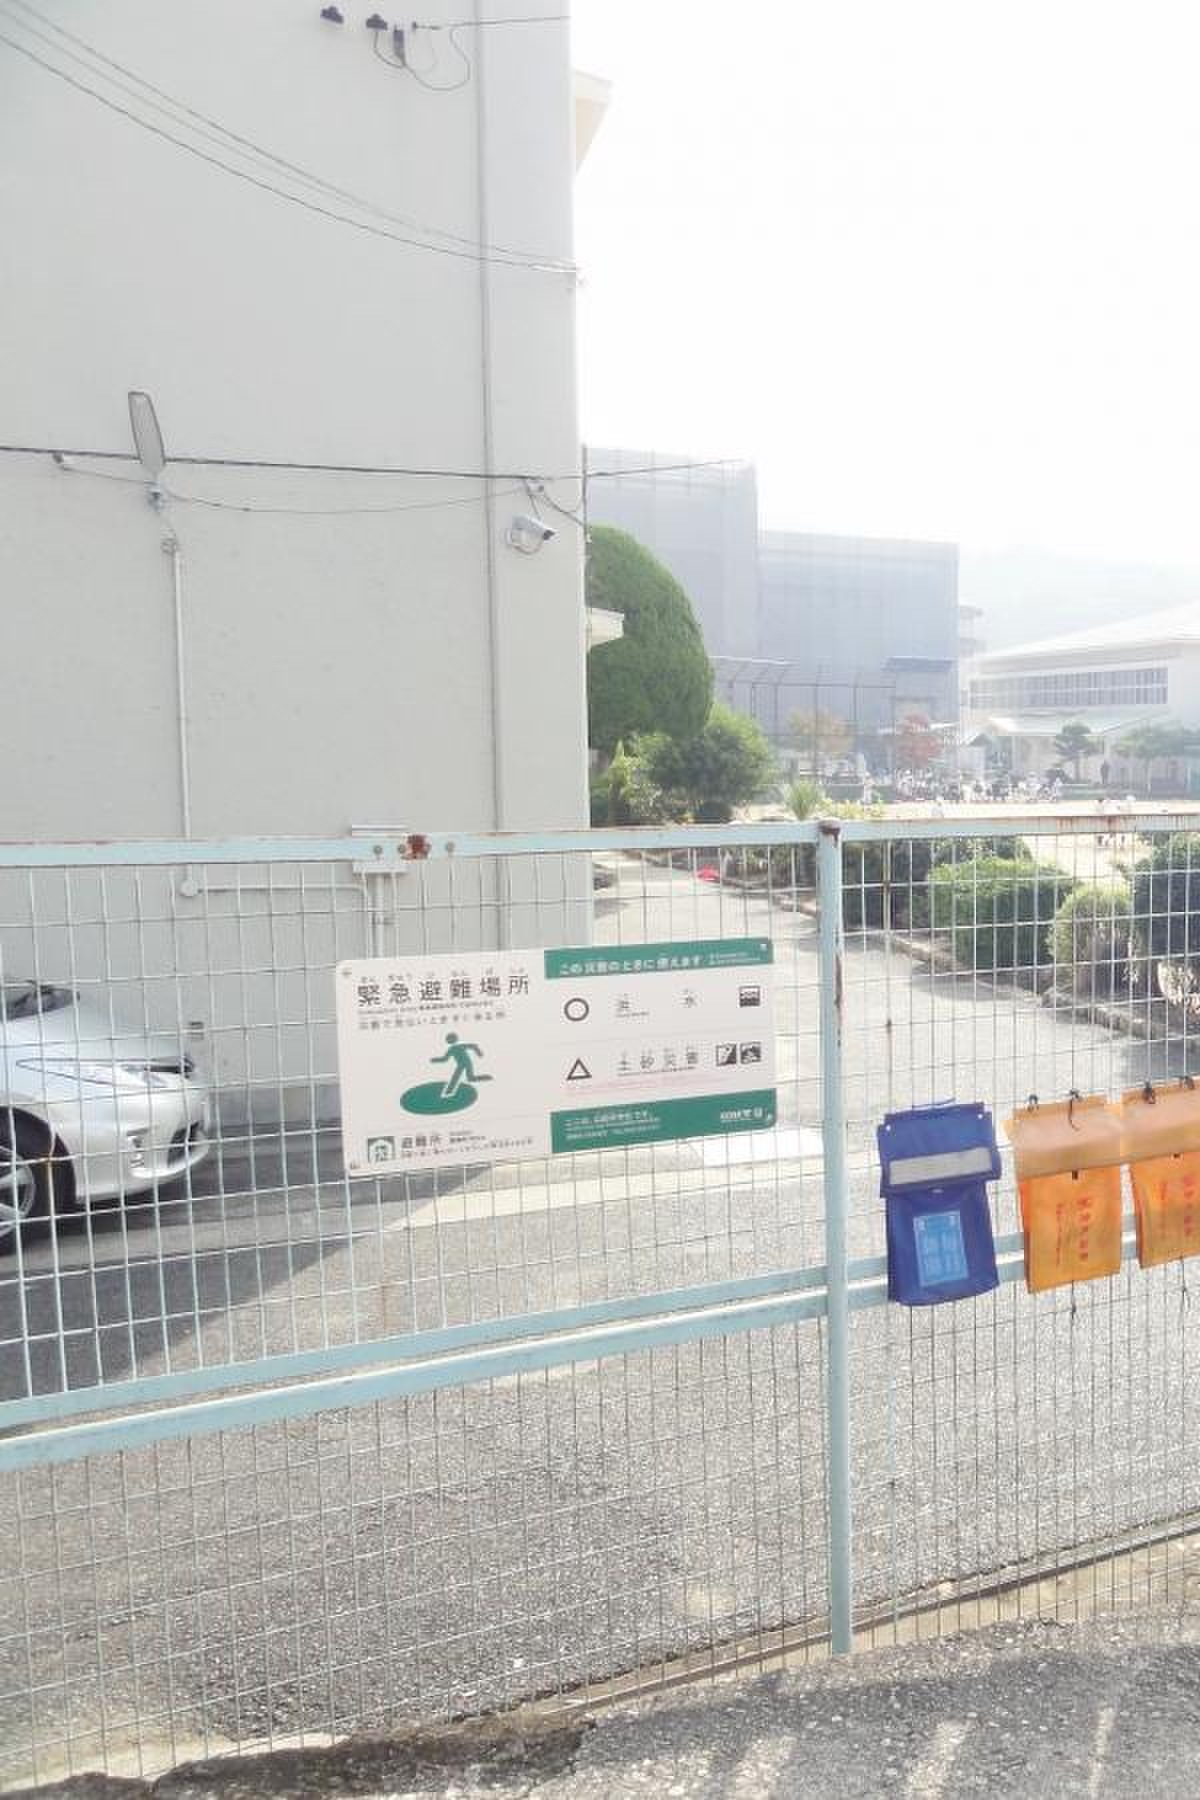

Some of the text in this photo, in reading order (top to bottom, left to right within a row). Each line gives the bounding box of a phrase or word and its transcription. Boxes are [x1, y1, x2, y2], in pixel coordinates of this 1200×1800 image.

[357, 976, 529, 1007] 緊急避難場所
